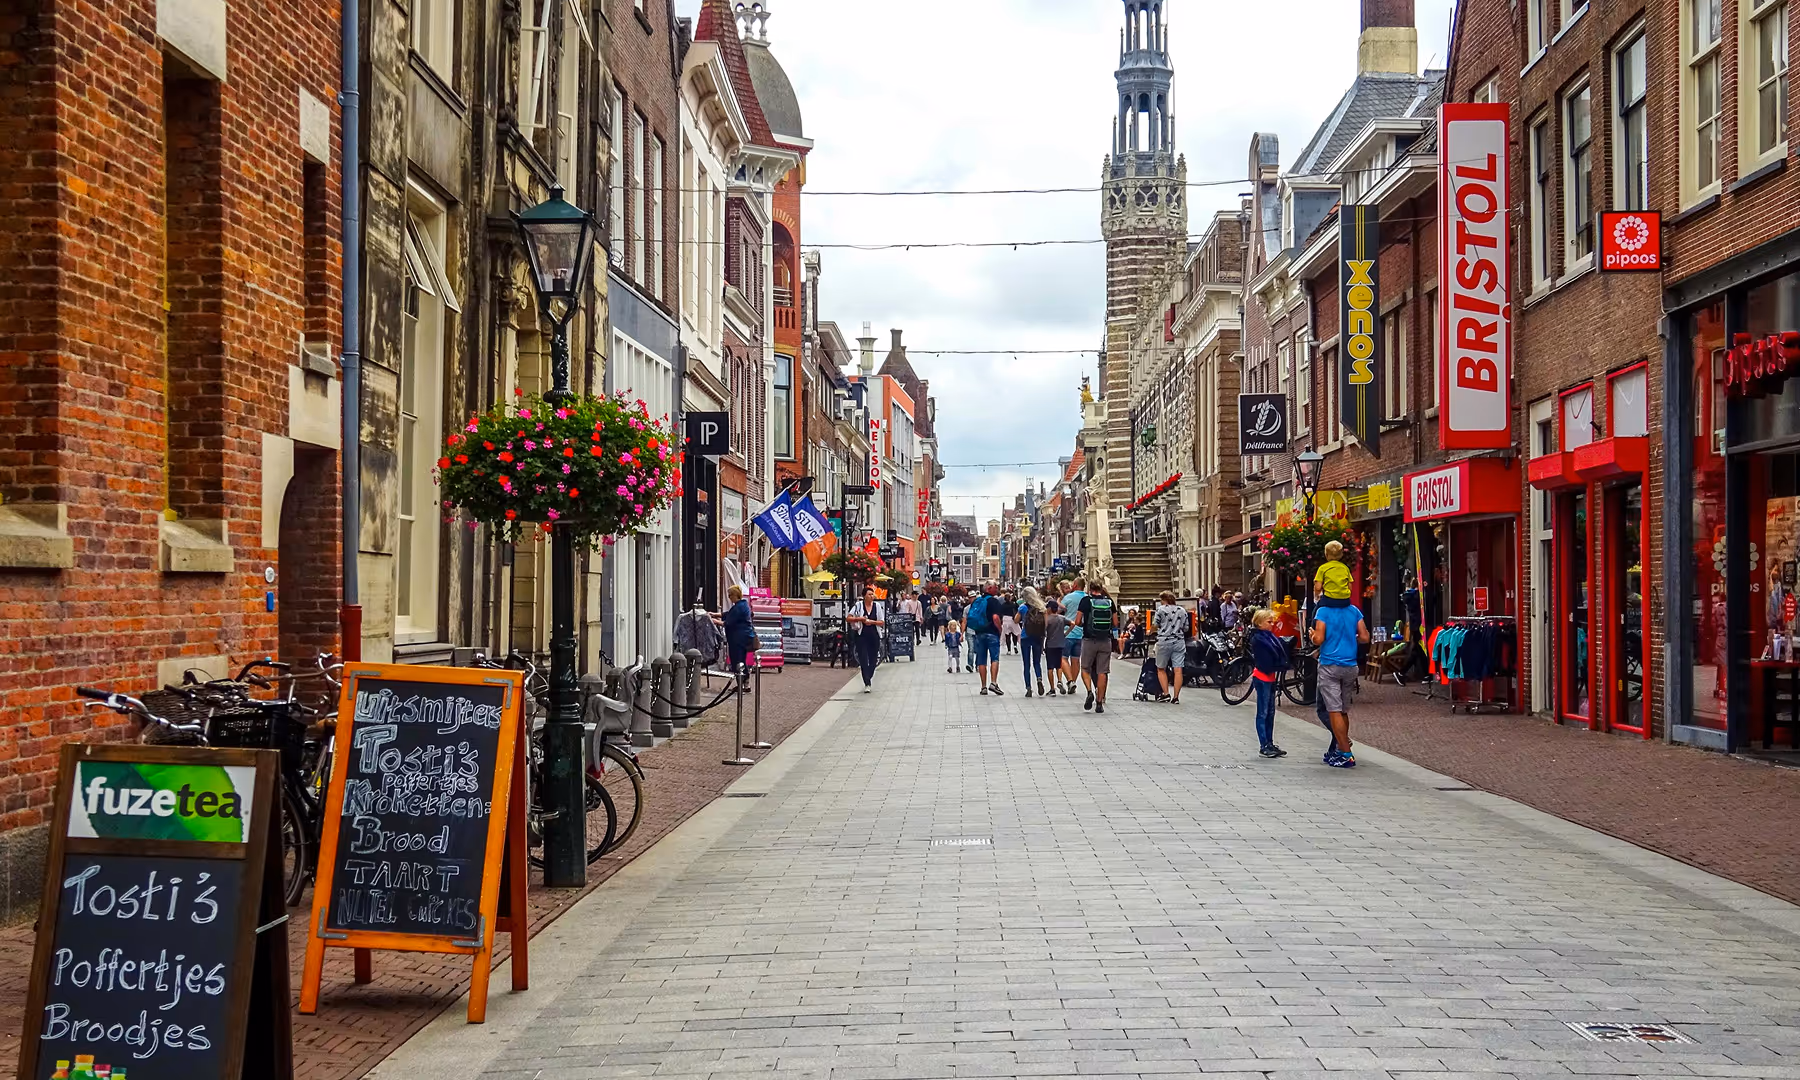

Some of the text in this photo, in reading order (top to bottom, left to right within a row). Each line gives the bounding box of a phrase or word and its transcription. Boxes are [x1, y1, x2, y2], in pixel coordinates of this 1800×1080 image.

[1453, 153, 1500, 393] BRISTOL
[1606, 251, 1657, 268] pipoos
[870, 419, 880, 490] NELSON
[1245, 441, 1284, 450] Délifrance
[917, 488, 930, 542] HEMA
[1417, 475, 1454, 512] BRISTOL
[354, 724, 480, 778] Tosti's
[351, 815, 450, 854] Brood
[63, 865, 219, 923] Tosti's
[345, 859, 459, 892] TAART
[54, 947, 226, 1010] Poffertjes
[41, 1003, 211, 1059] Broodjes
